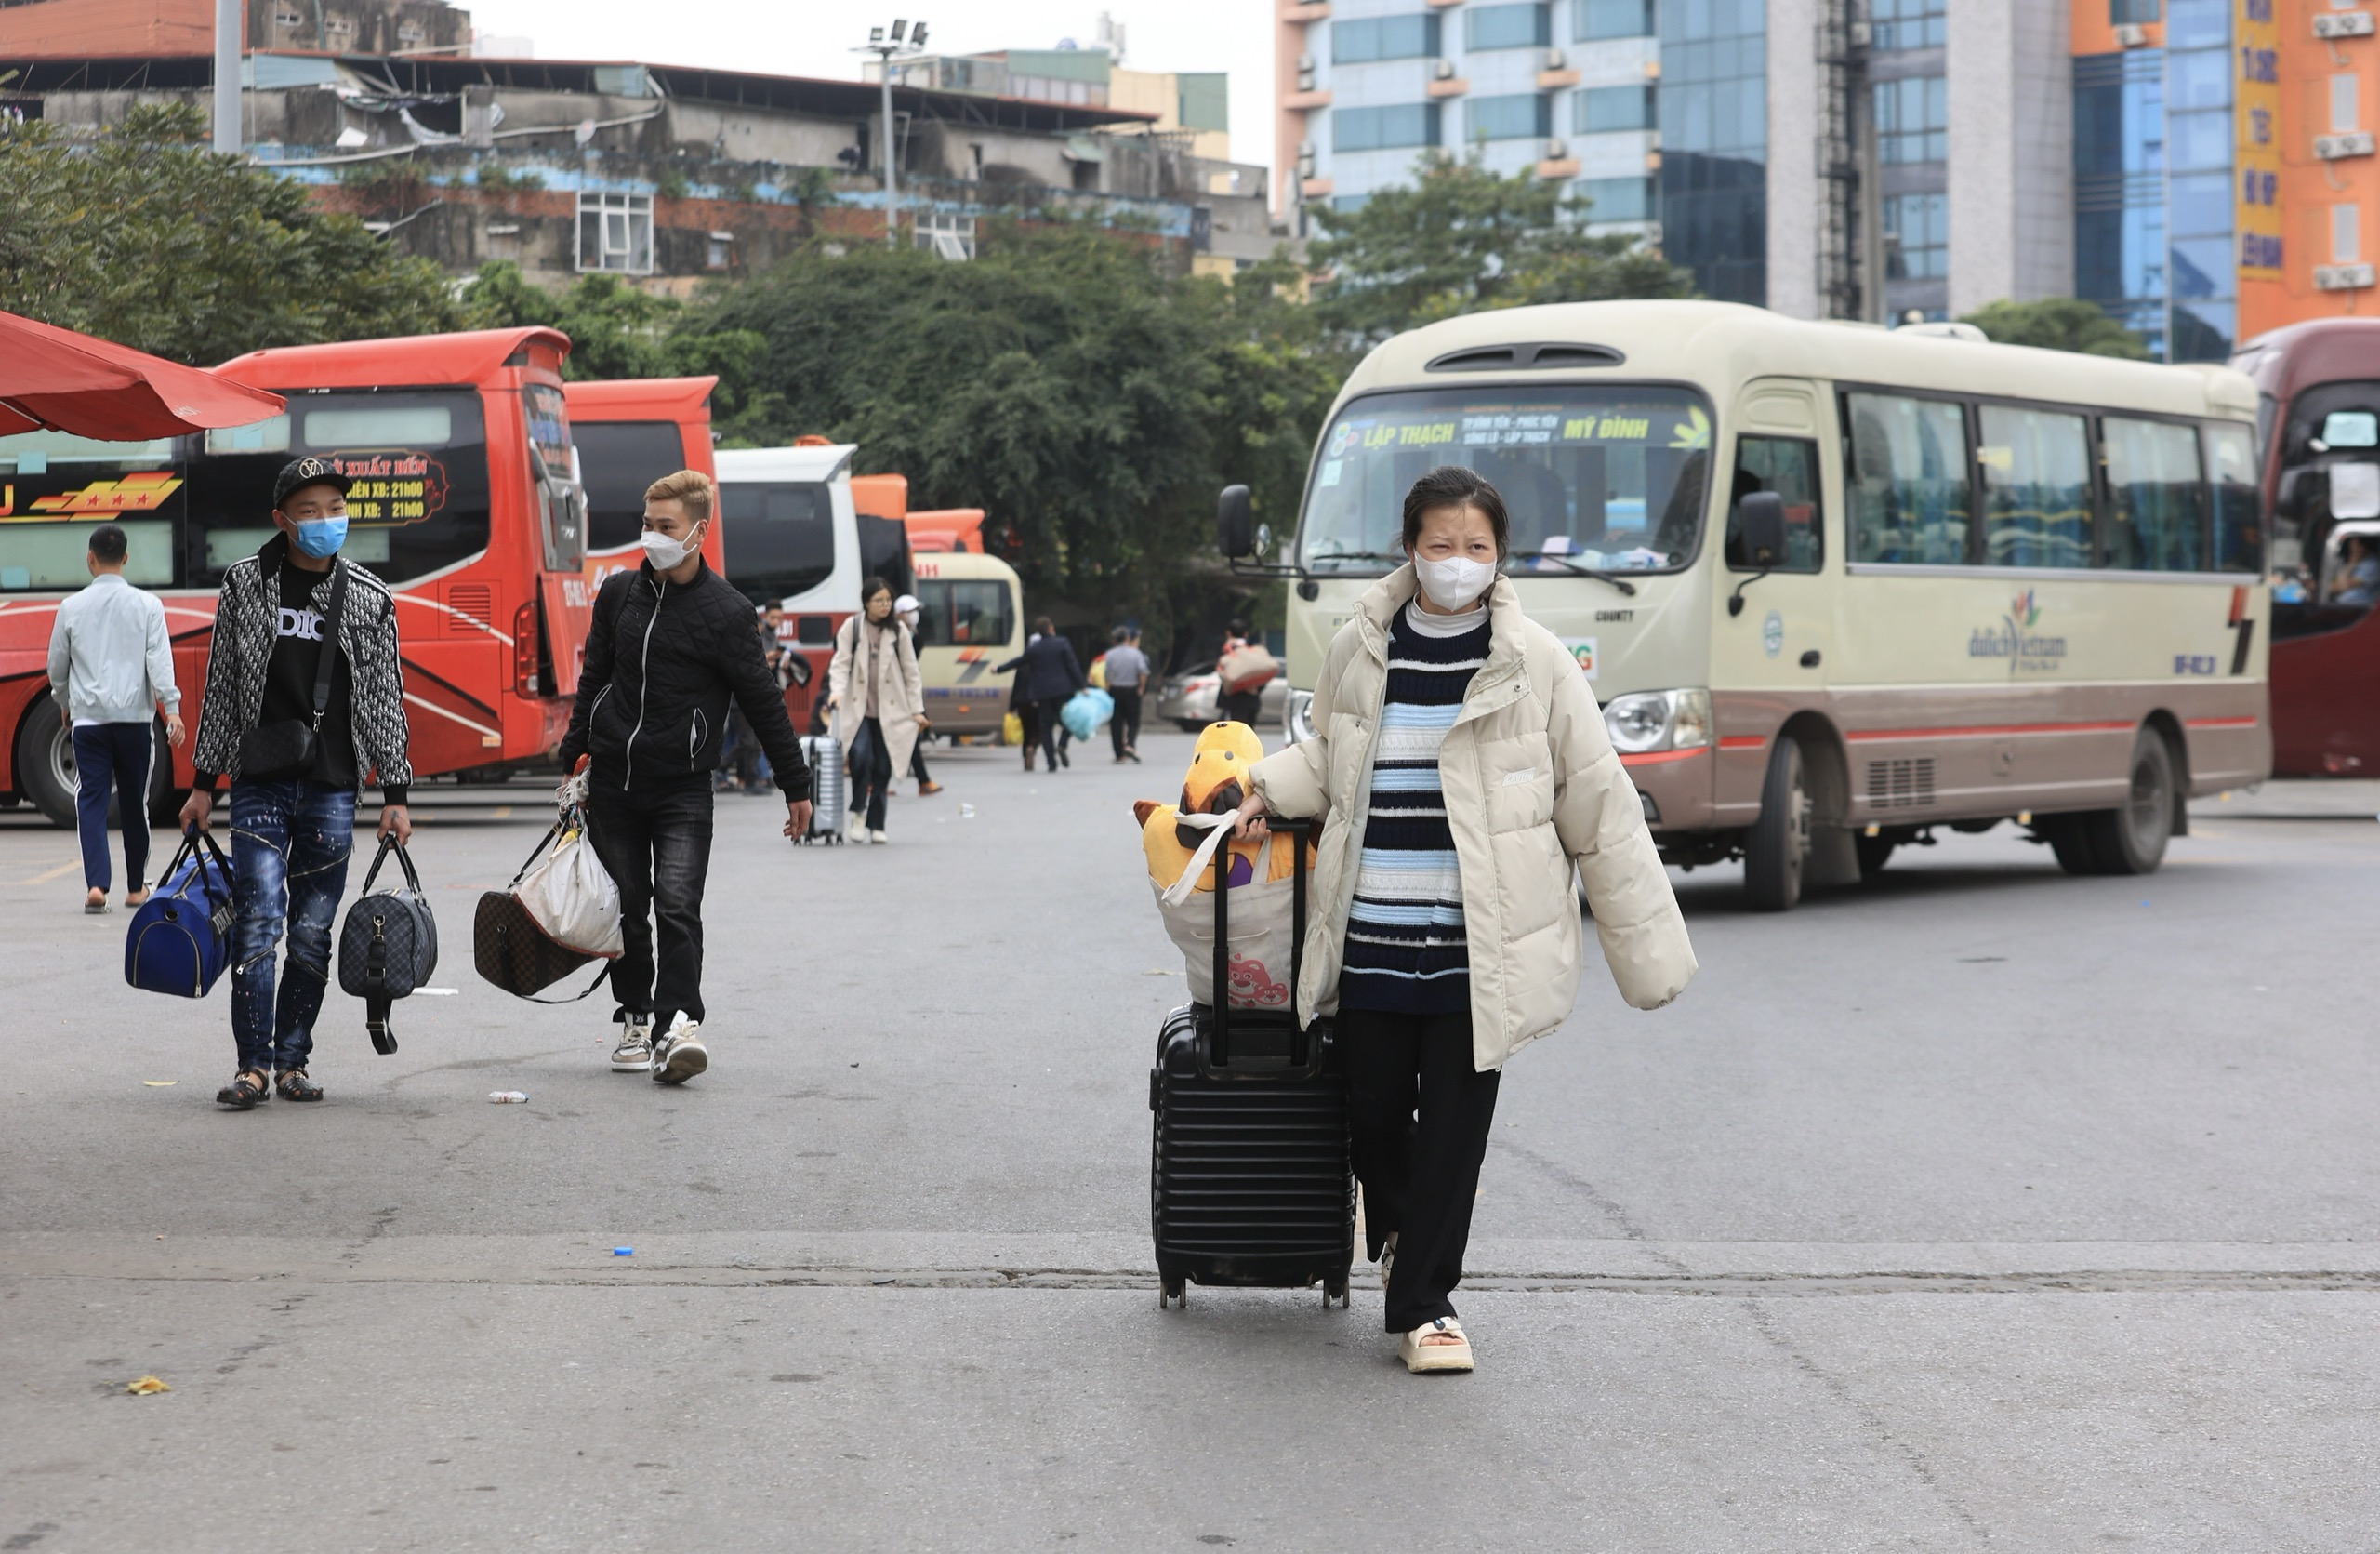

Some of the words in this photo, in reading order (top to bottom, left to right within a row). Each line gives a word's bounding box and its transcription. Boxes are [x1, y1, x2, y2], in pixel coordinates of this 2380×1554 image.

[1364, 424, 1396, 449] LẬP
[1400, 423, 1455, 447] THẠCH
[1564, 416, 1596, 439] MỸ
[1598, 416, 1649, 439] ĐÌNH
[346, 455, 392, 476] XUẤT
[394, 455, 428, 475] BẾN
[372, 481, 390, 498] XB:
[391, 481, 423, 498] 21h00
[364, 502, 381, 518] XB:
[392, 501, 424, 518] 21h00
[1595, 609, 1634, 622] COUNTY
